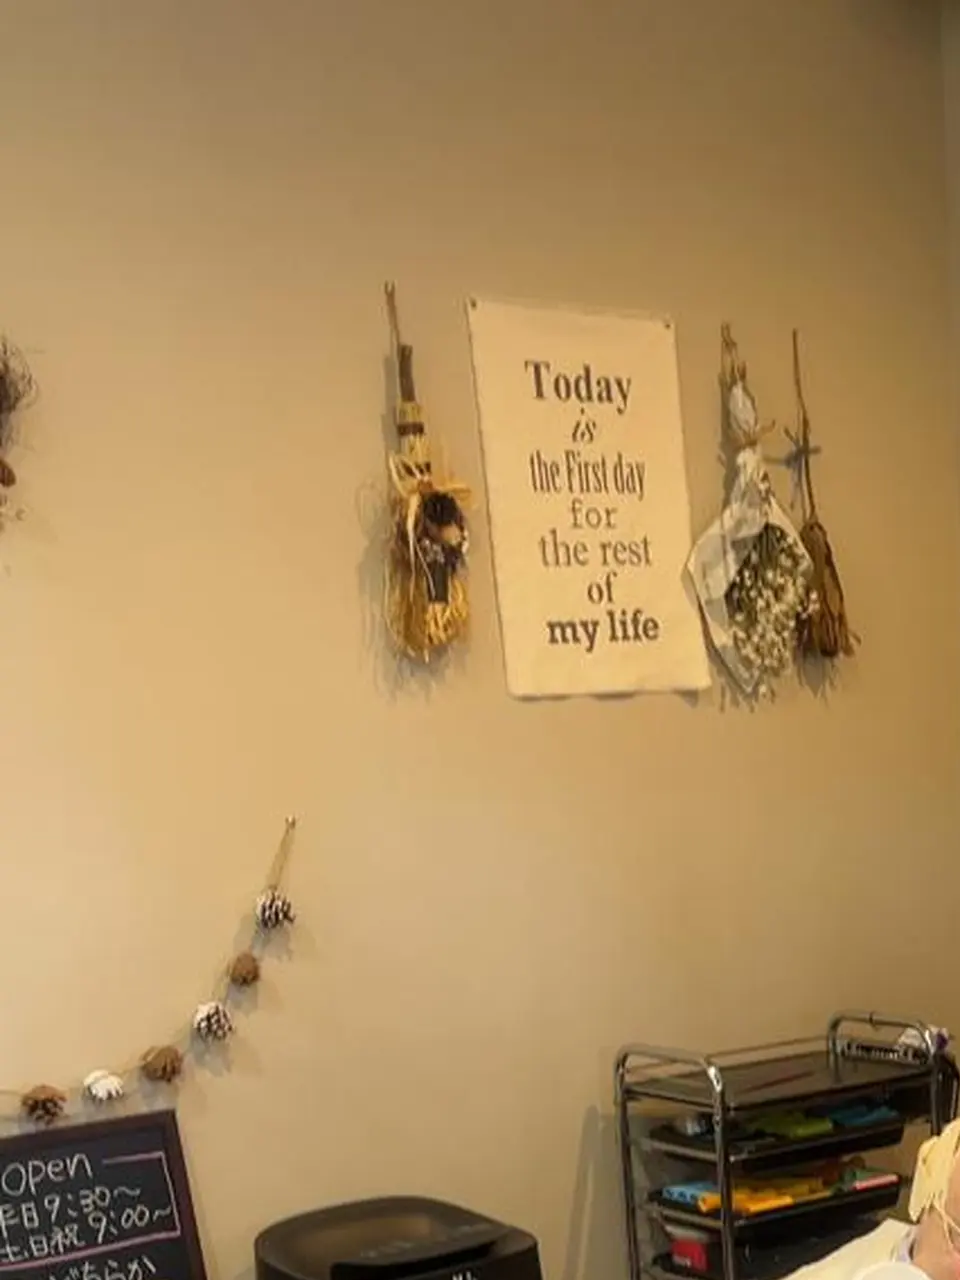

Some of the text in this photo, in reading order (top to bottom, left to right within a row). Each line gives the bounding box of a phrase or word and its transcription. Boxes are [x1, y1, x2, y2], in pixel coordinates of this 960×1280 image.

[524, 360, 632, 415] Today
[572, 406, 597, 443] is
[530, 449, 561, 494] the
[613, 451, 645, 501] day
[570, 498, 617, 530] for
[538, 528, 652, 567] the rest
[587, 571, 617, 604] of
[547, 608, 660, 653] my life
